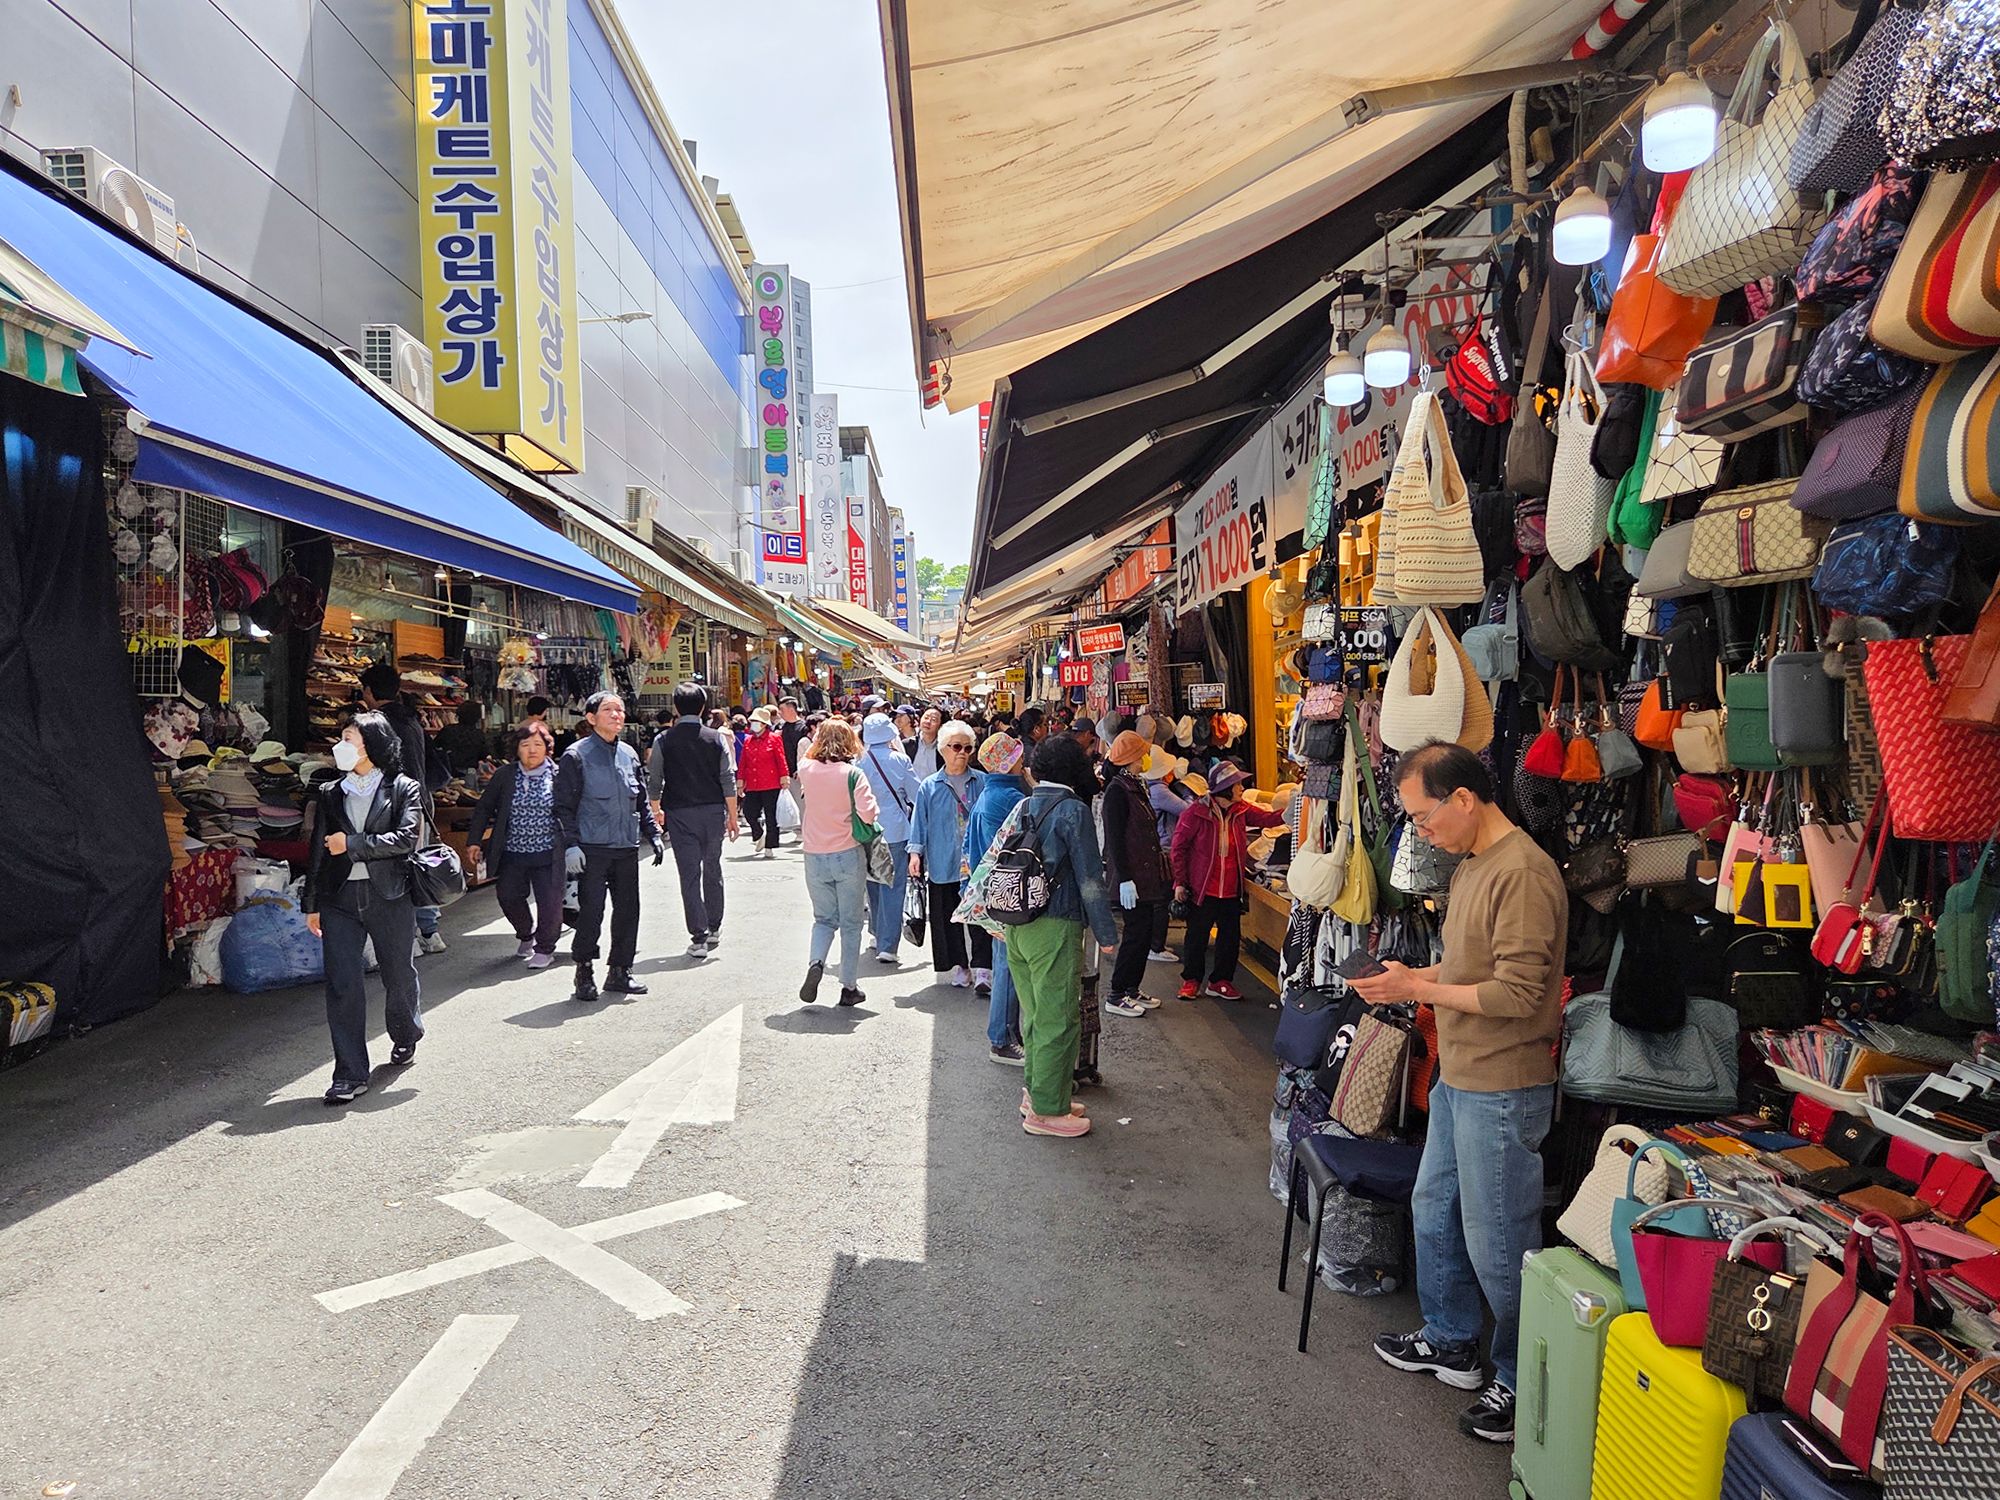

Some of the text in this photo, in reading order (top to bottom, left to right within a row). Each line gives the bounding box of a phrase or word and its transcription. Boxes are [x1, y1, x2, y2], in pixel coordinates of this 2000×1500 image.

[1488, 325, 1510, 383] Supreme
[1340, 609, 1386, 622] 카프 SCA
[678, 636, 692, 671] 가죽벨트
[1063, 665, 1089, 683] BYC
